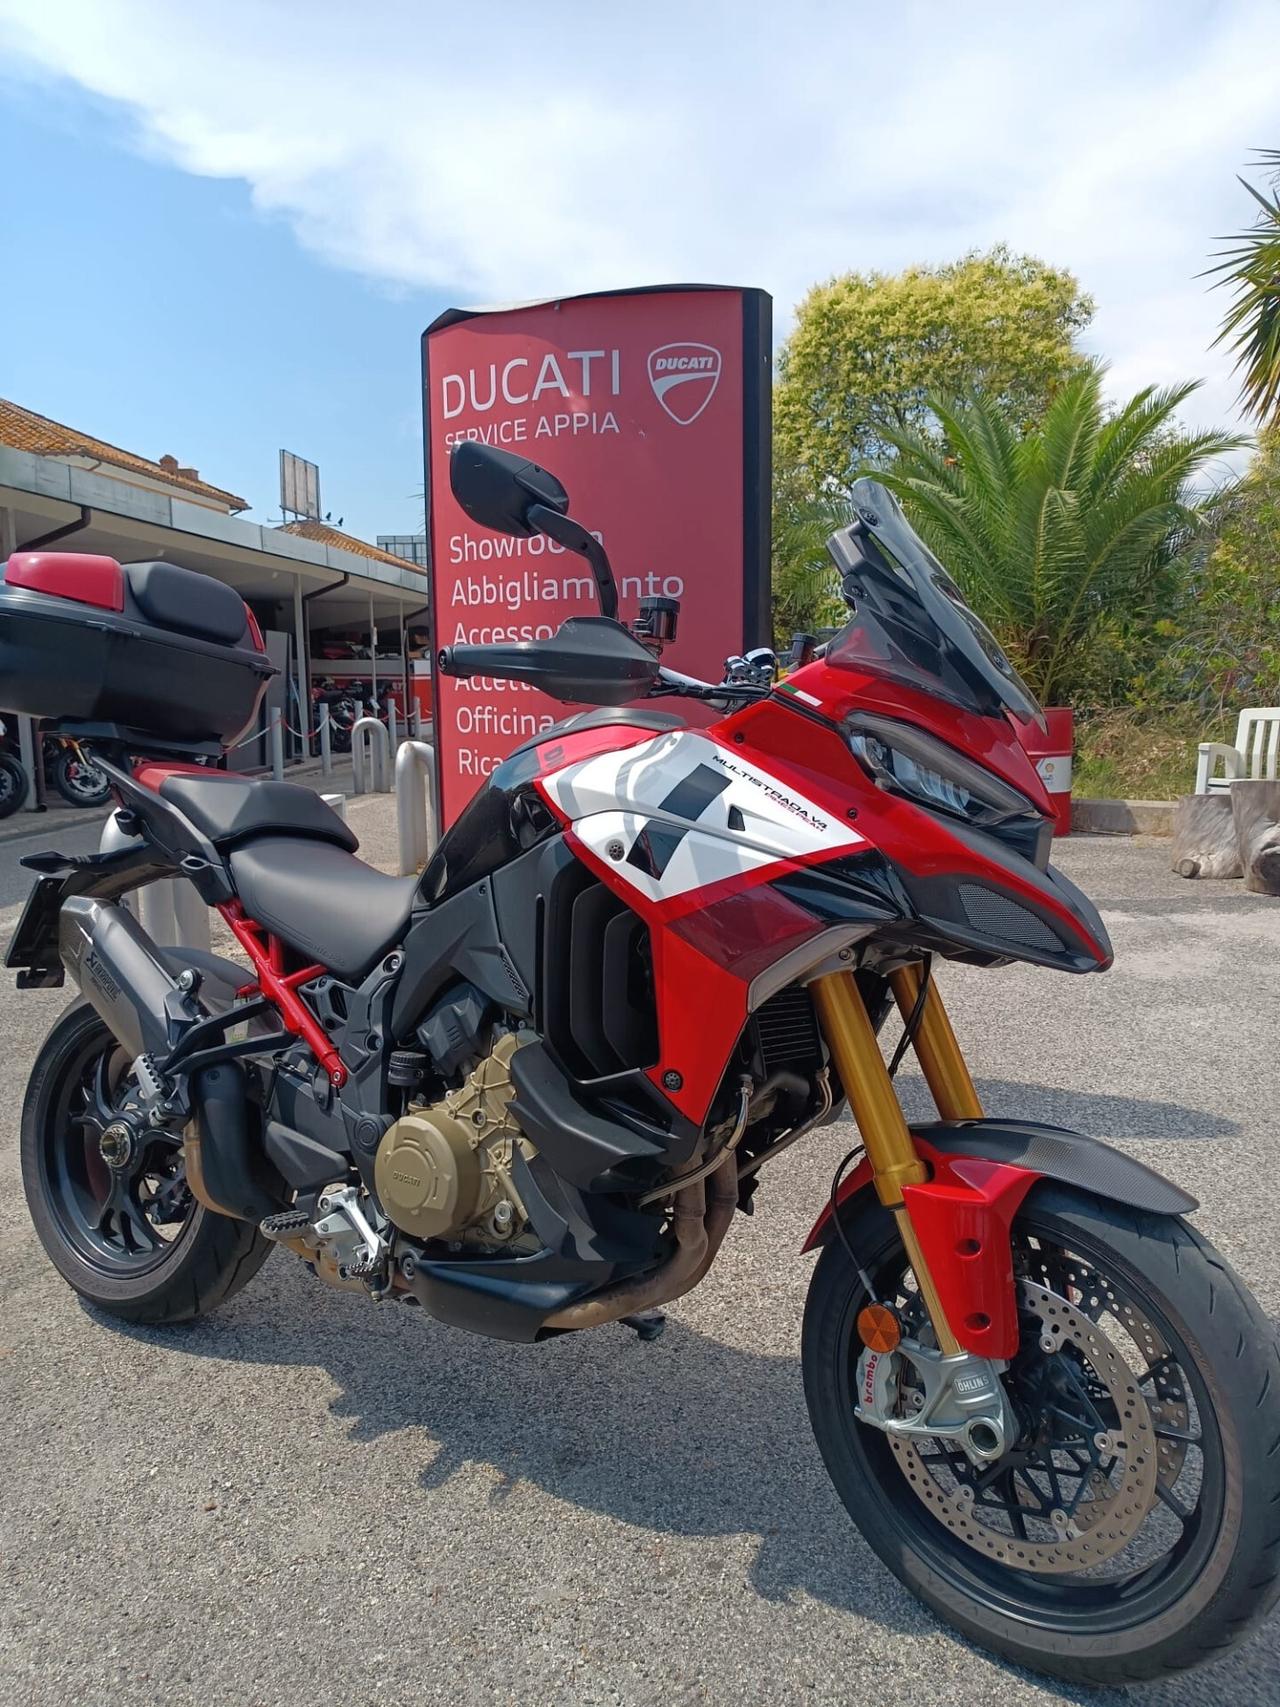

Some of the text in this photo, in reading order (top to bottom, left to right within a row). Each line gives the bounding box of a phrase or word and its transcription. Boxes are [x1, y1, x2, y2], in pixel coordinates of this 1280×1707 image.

[655, 356, 713, 371] DUCATI
[442, 349, 620, 420] DUCATI
[534, 411, 620, 439] APPIA
[451, 571, 684, 610] Abbigliamnto
[453, 622, 562, 646] Accesso
[456, 705, 555, 736] Officina
[458, 748, 504, 777] Rica
[712, 755, 828, 829] MULTISTRADA V4
[864, 1354, 878, 1404] brembo
